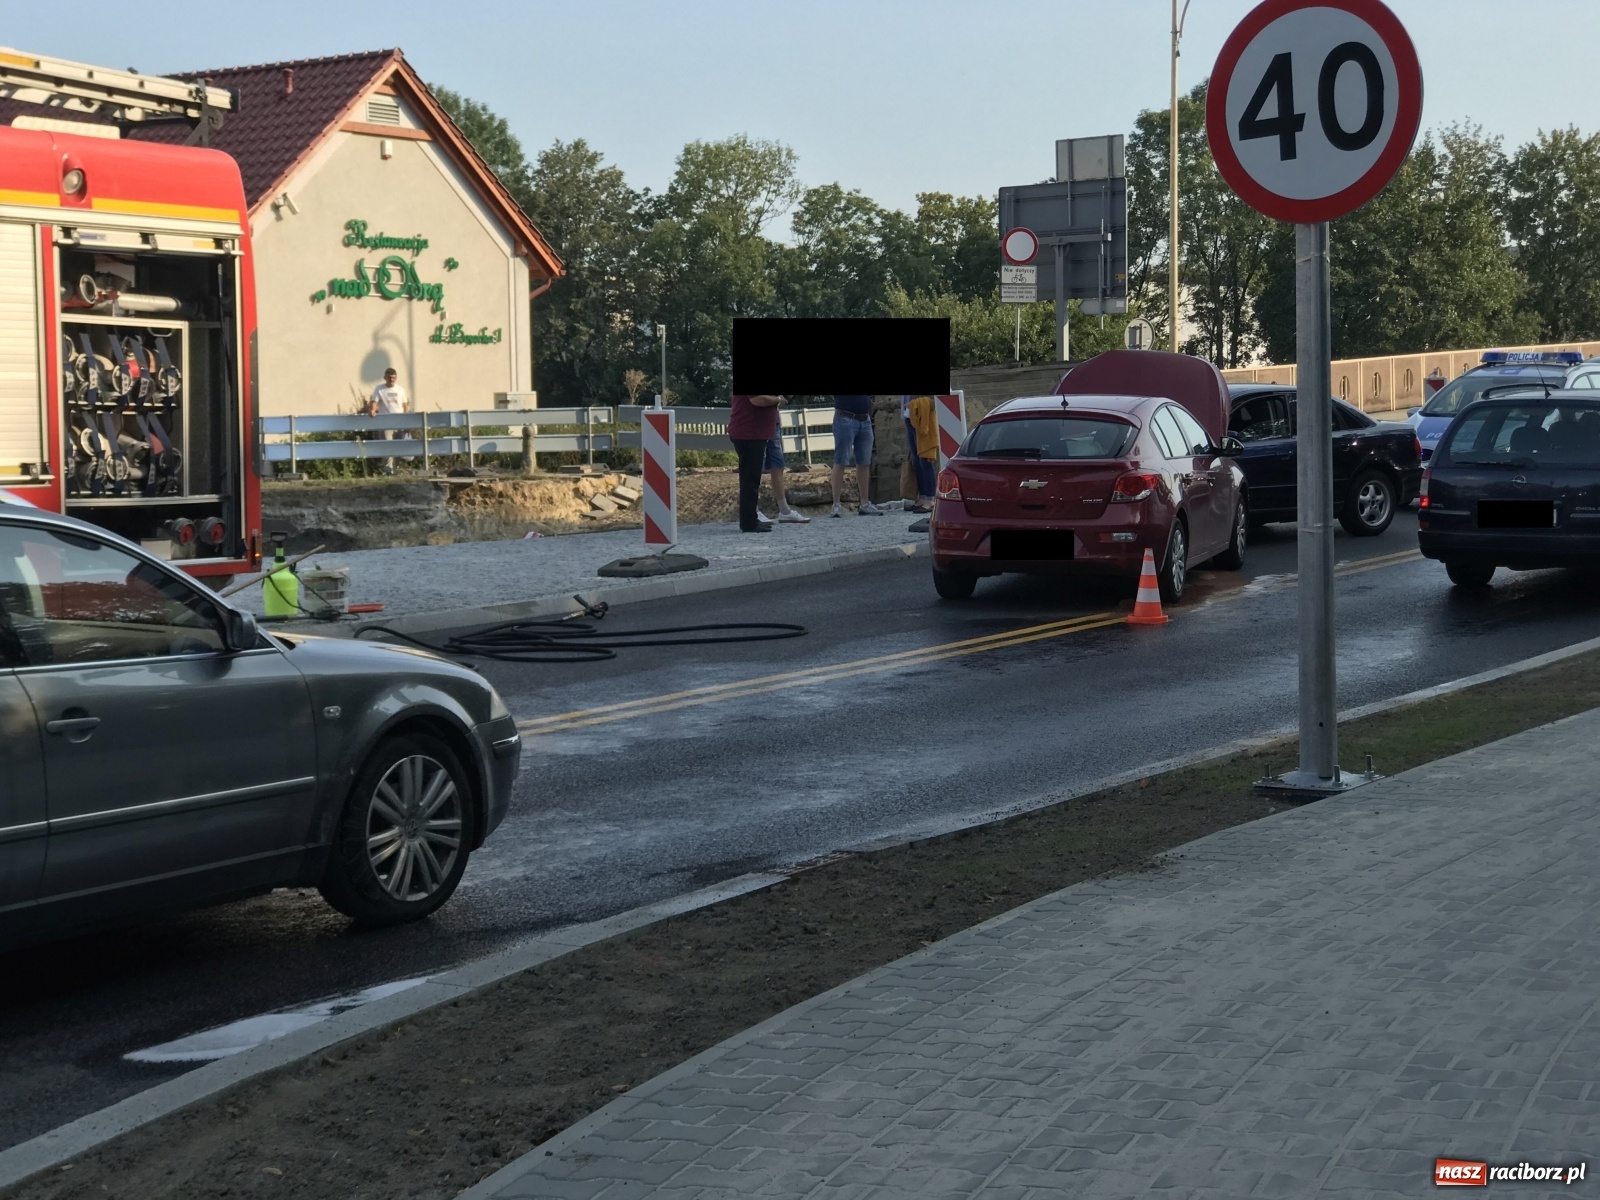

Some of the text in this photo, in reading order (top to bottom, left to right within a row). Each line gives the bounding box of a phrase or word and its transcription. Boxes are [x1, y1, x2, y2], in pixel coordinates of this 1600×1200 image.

[1238, 41, 1384, 162] 40
[344, 219, 429, 257] Restauracja
[1508, 352, 1539, 361] POLICJA
